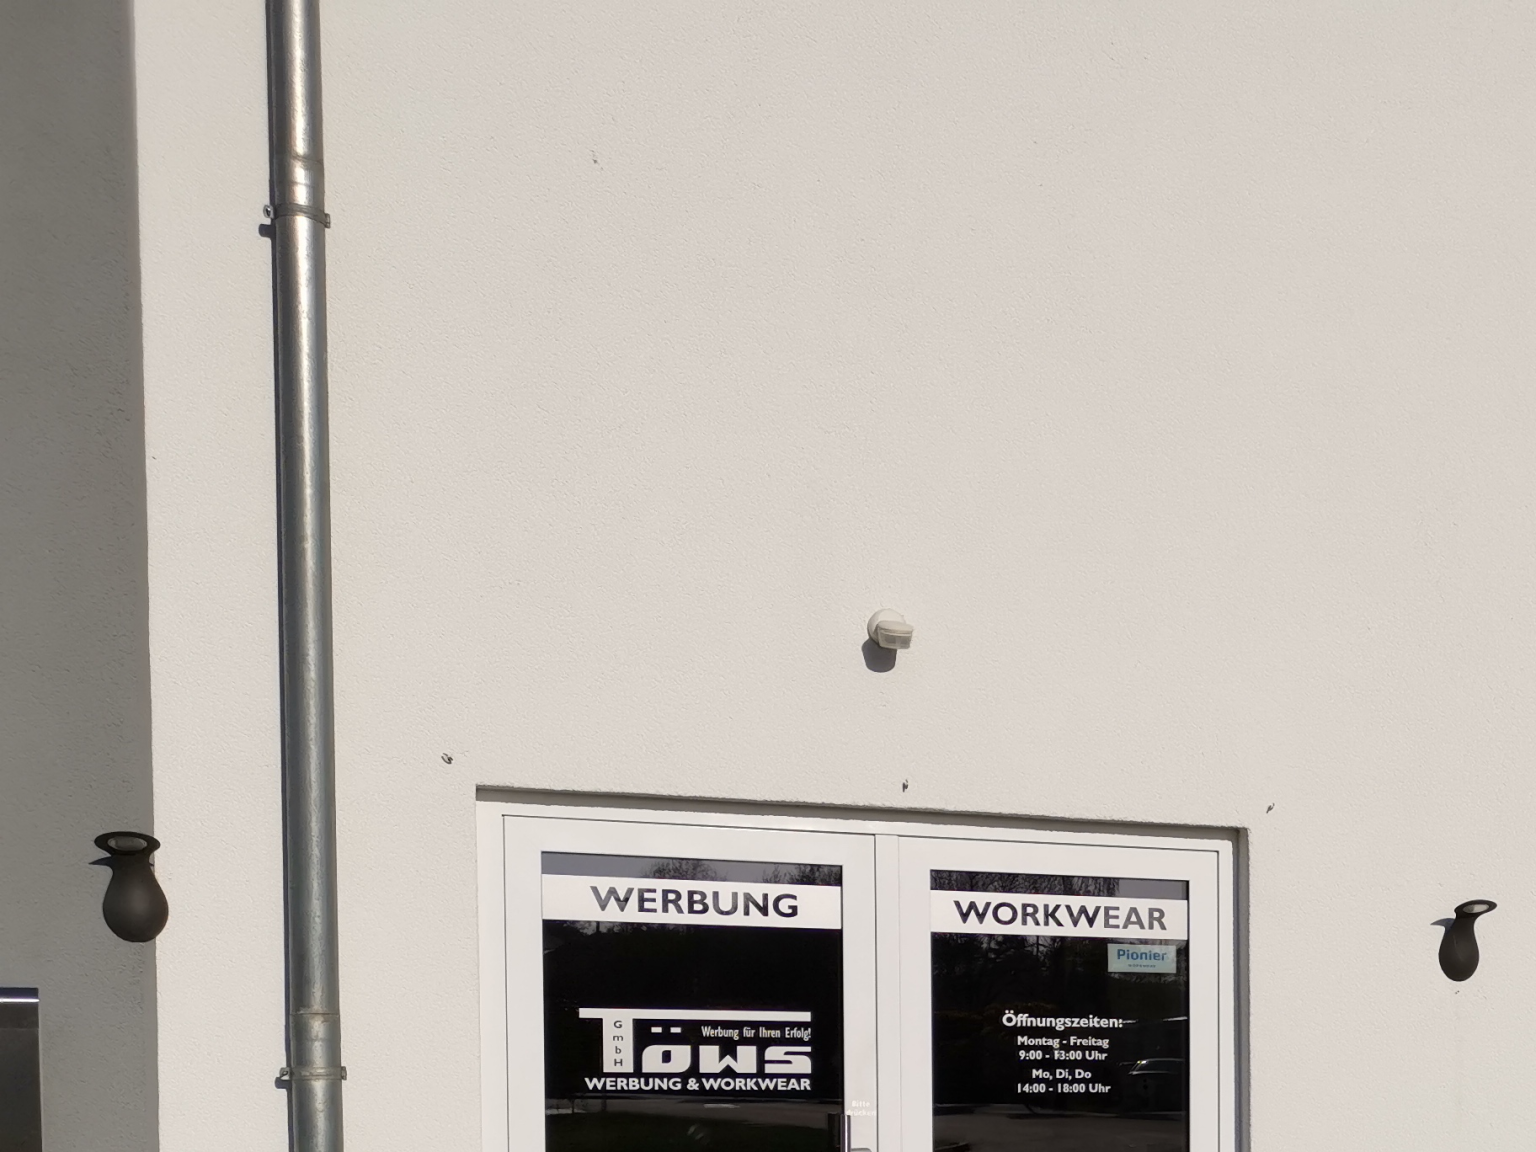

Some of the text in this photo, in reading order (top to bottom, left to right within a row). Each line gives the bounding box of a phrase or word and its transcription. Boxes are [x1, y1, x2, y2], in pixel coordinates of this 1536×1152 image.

[589, 885, 799, 918] WERBUNG
[953, 900, 1168, 931] WORKWEAR
[1116, 948, 1167, 961] Pionier
[1002, 1009, 1123, 1031] Öffnungszeiten:
[701, 1025, 812, 1041] Werbung für Ihren Erfolg!
[1017, 1035, 1061, 1049] Montag
[1069, 1036, 1110, 1049] Freitag
[1018, 1050, 1043, 1060] 9:00
[1085, 1050, 1108, 1060] Uhr
[1031, 1068, 1092, 1080] Mo, Di, Do
[584, 1077, 812, 1091] WERBUNG & WORKWEAR
[1017, 1083, 1046, 1093] 14:00
[1057, 1083, 1086, 1093] 18:00
[1088, 1083, 1112, 1093] Uhr
